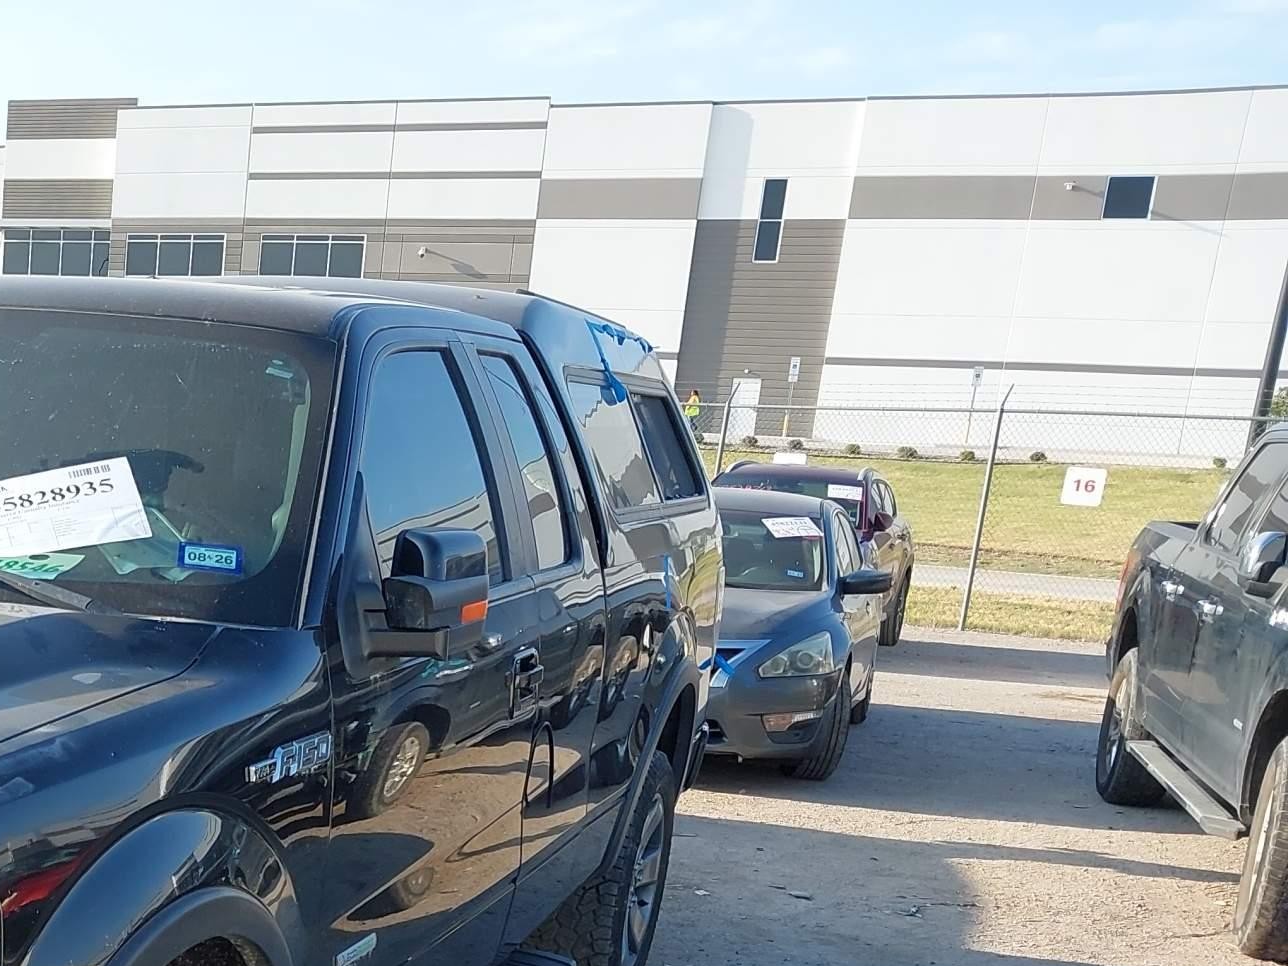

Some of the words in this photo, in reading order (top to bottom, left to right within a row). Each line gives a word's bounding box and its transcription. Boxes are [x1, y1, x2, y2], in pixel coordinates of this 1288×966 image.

[1073, 479, 1096, 493] 16
[188, 551, 207, 562] 08
[214, 554, 233, 565] 26
